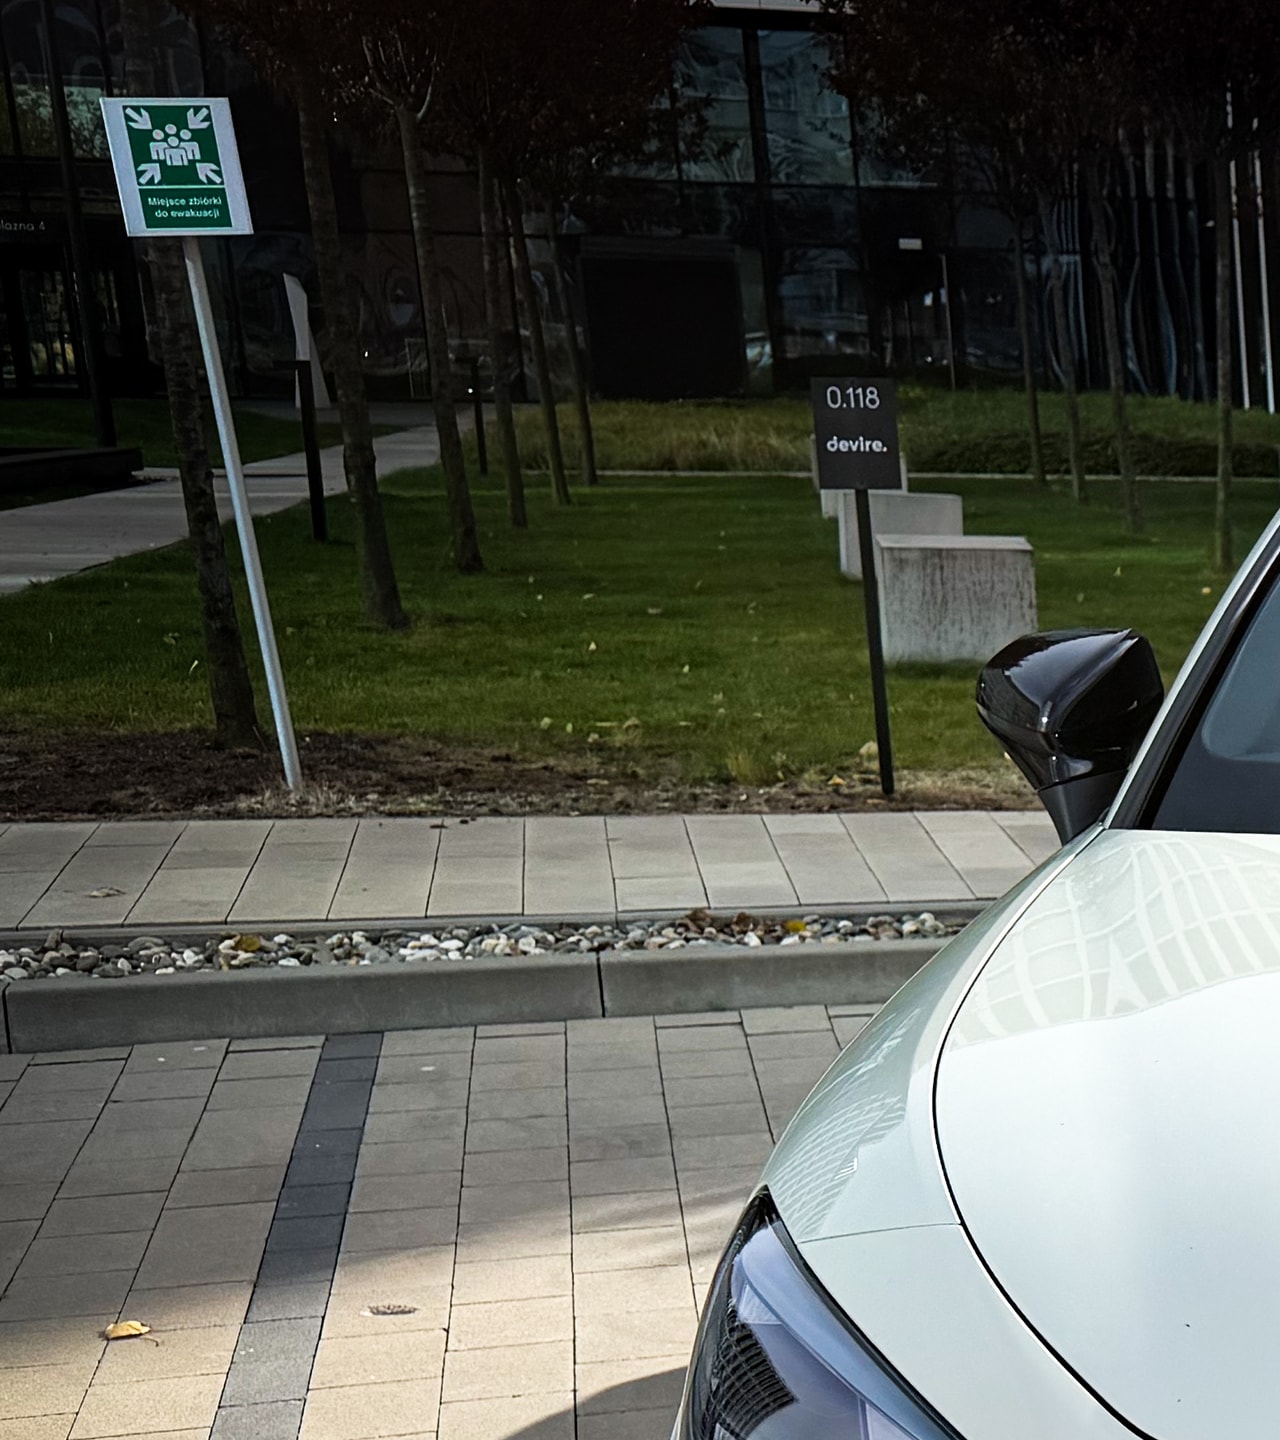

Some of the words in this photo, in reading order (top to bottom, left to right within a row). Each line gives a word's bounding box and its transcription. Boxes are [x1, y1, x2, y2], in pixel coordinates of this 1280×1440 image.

[147, 197, 186, 208] Miejsce
[189, 196, 222, 206] zbiórki
[155, 209, 169, 218] do
[170, 208, 220, 219] ewakuacji
[38, 219, 46, 231] 4
[826, 386, 880, 409] 0.118
[826, 435, 888, 452] devire.
